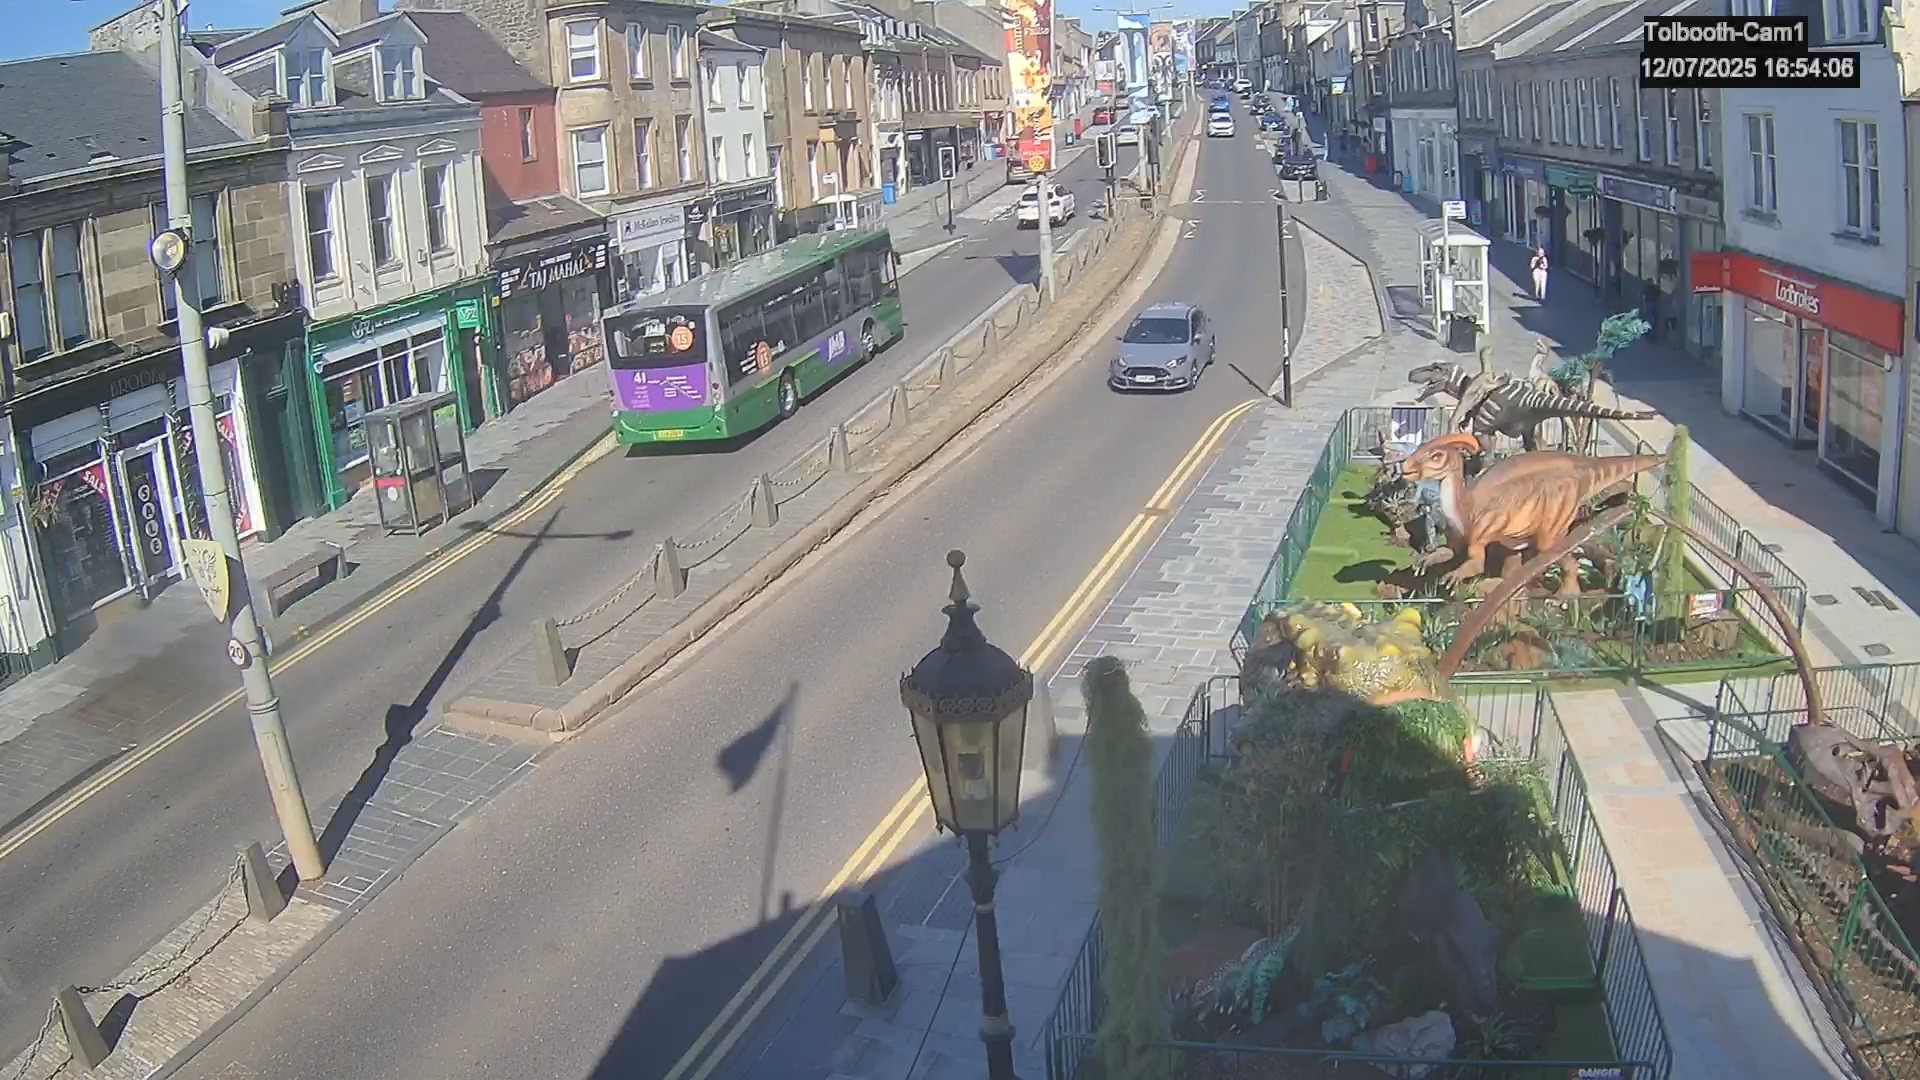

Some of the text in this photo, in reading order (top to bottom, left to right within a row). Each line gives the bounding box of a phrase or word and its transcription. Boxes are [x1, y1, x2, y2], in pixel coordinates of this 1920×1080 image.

[529, 271, 547, 291] TAJ
[549, 258, 585, 284] MAHAL
[1775, 279, 1820, 314] Ladbrokes
[676, 333, 688, 344] 15
[633, 371, 647, 384] 41
[82, 470, 106, 495] SALE
[140, 486, 161, 553] SALE
[229, 645, 244, 660] 20
